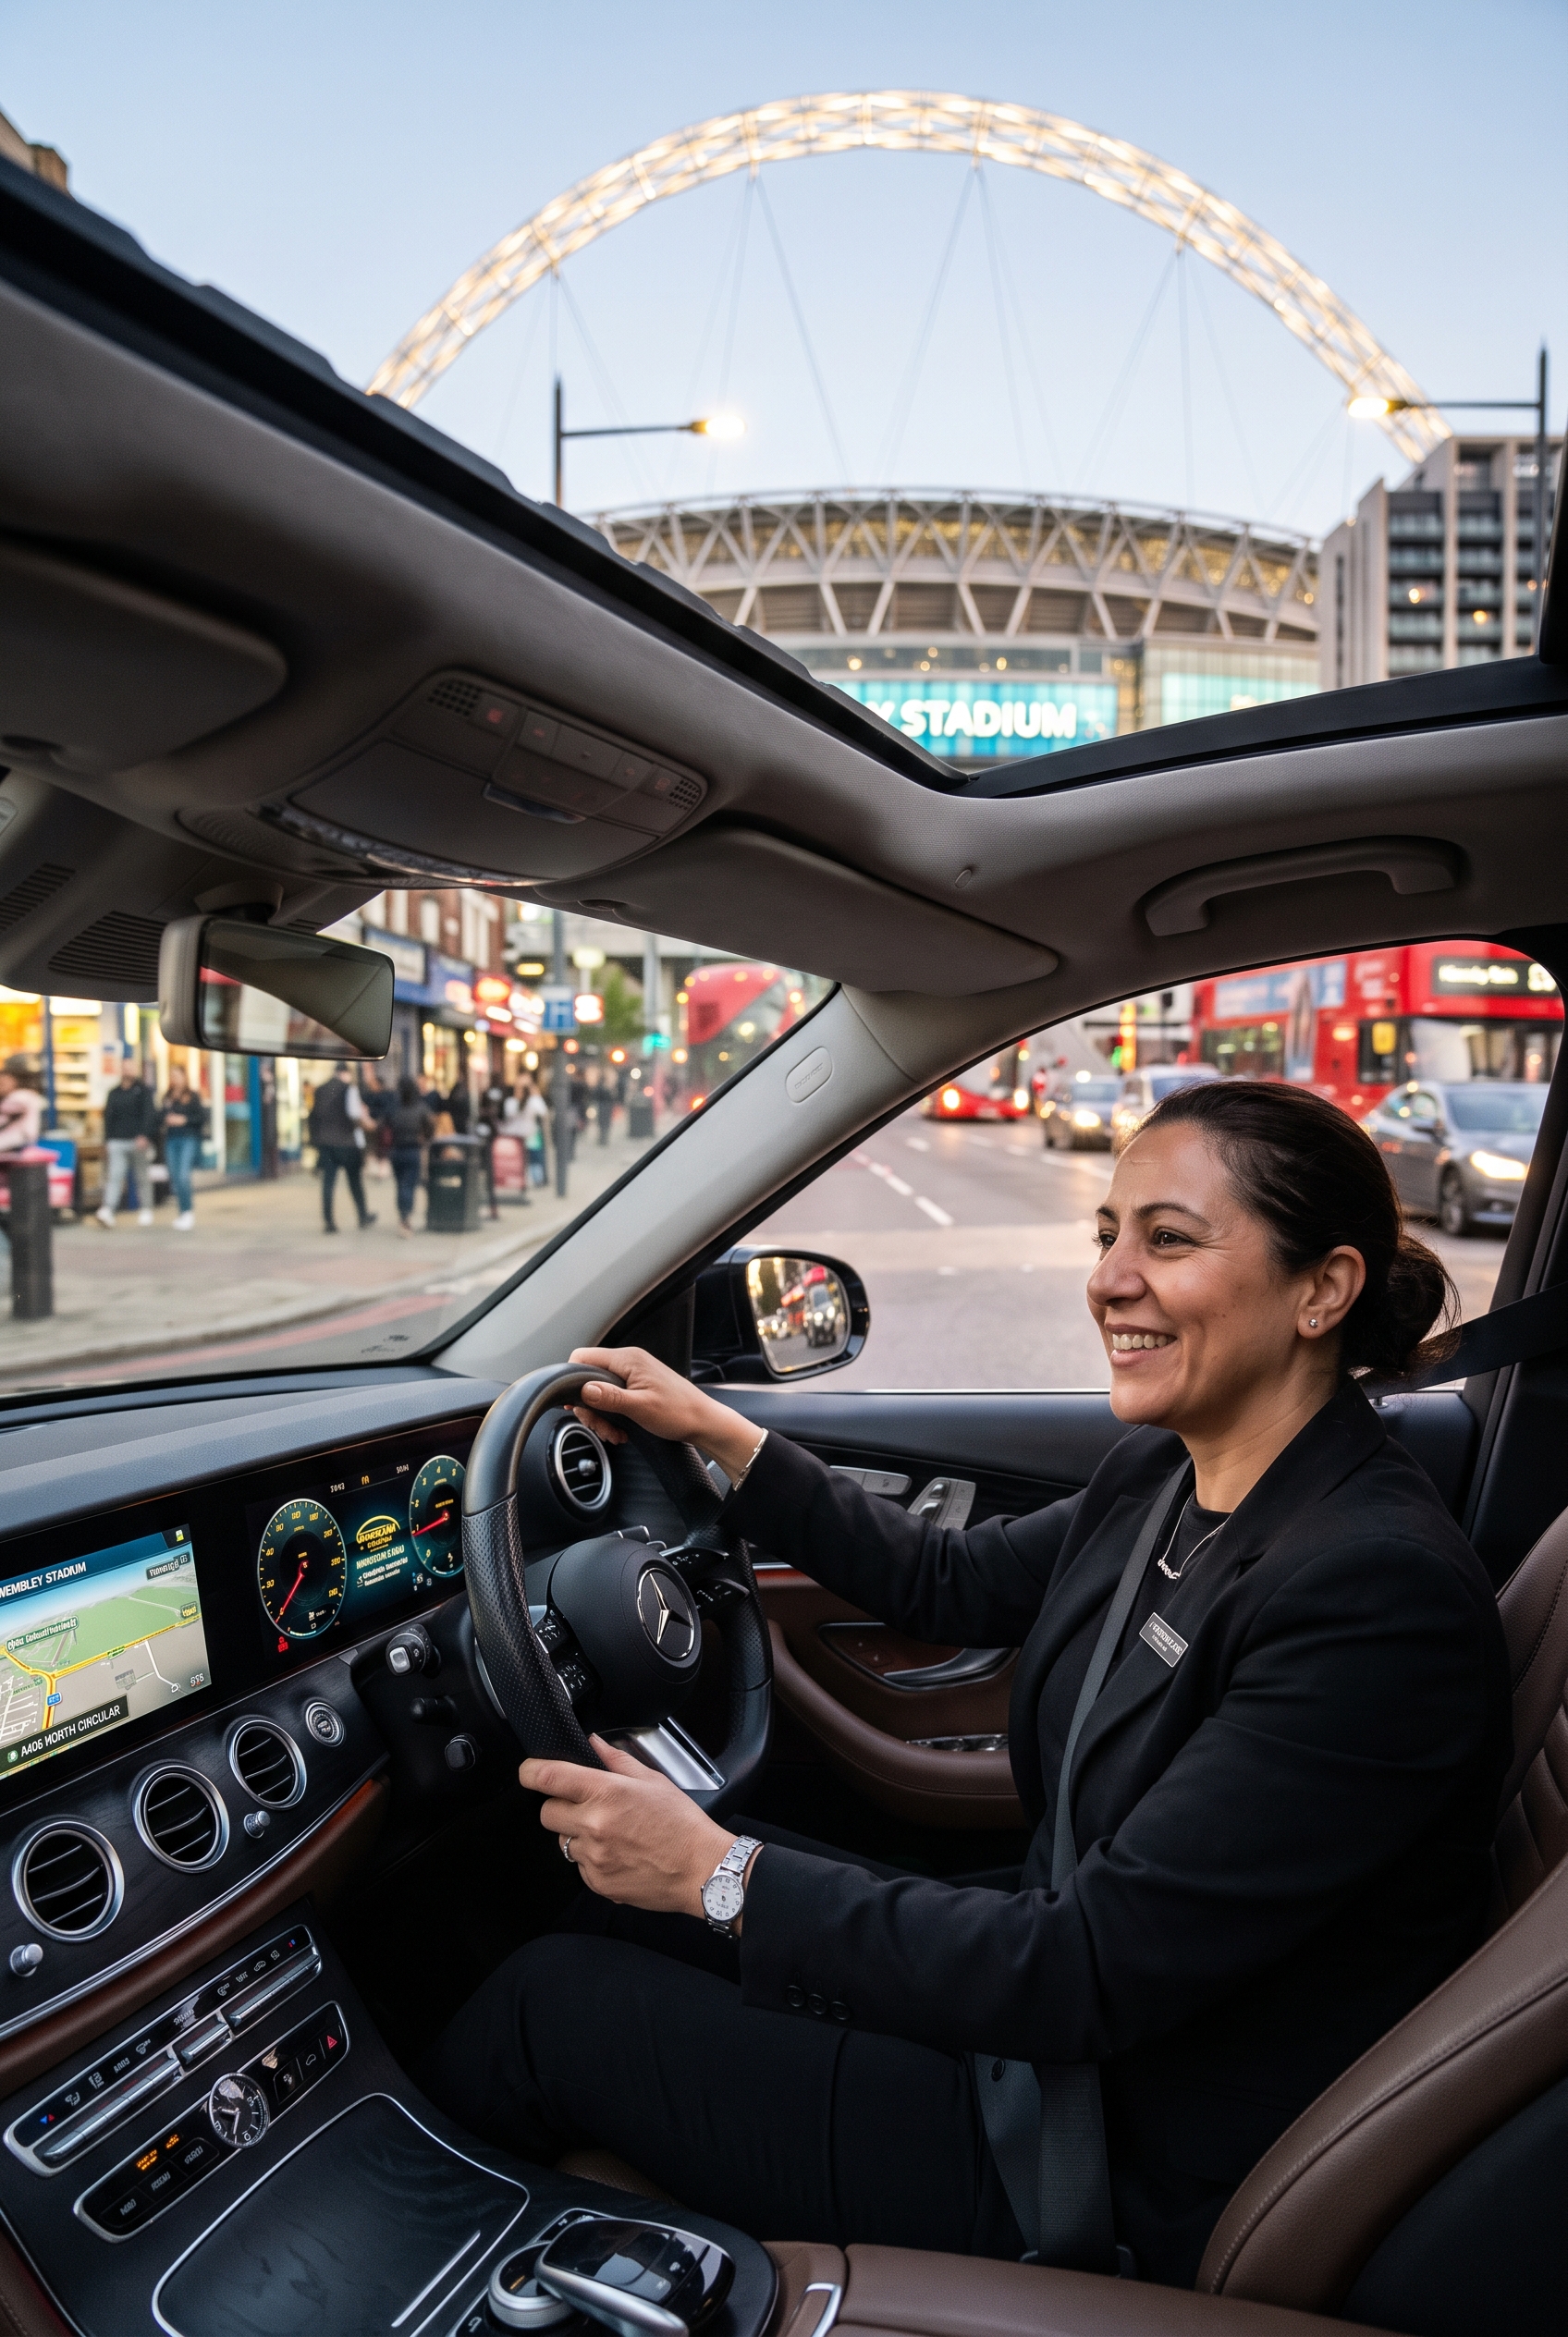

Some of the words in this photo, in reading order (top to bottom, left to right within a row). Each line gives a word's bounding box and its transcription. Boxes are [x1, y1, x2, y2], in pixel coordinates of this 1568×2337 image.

[900, 699, 1077, 739] STADIUM
[45, 1560, 87, 1584] STADIUM
[44, 1723, 76, 1746] NORTH
[78, 1704, 121, 1731] CIRCULAR
